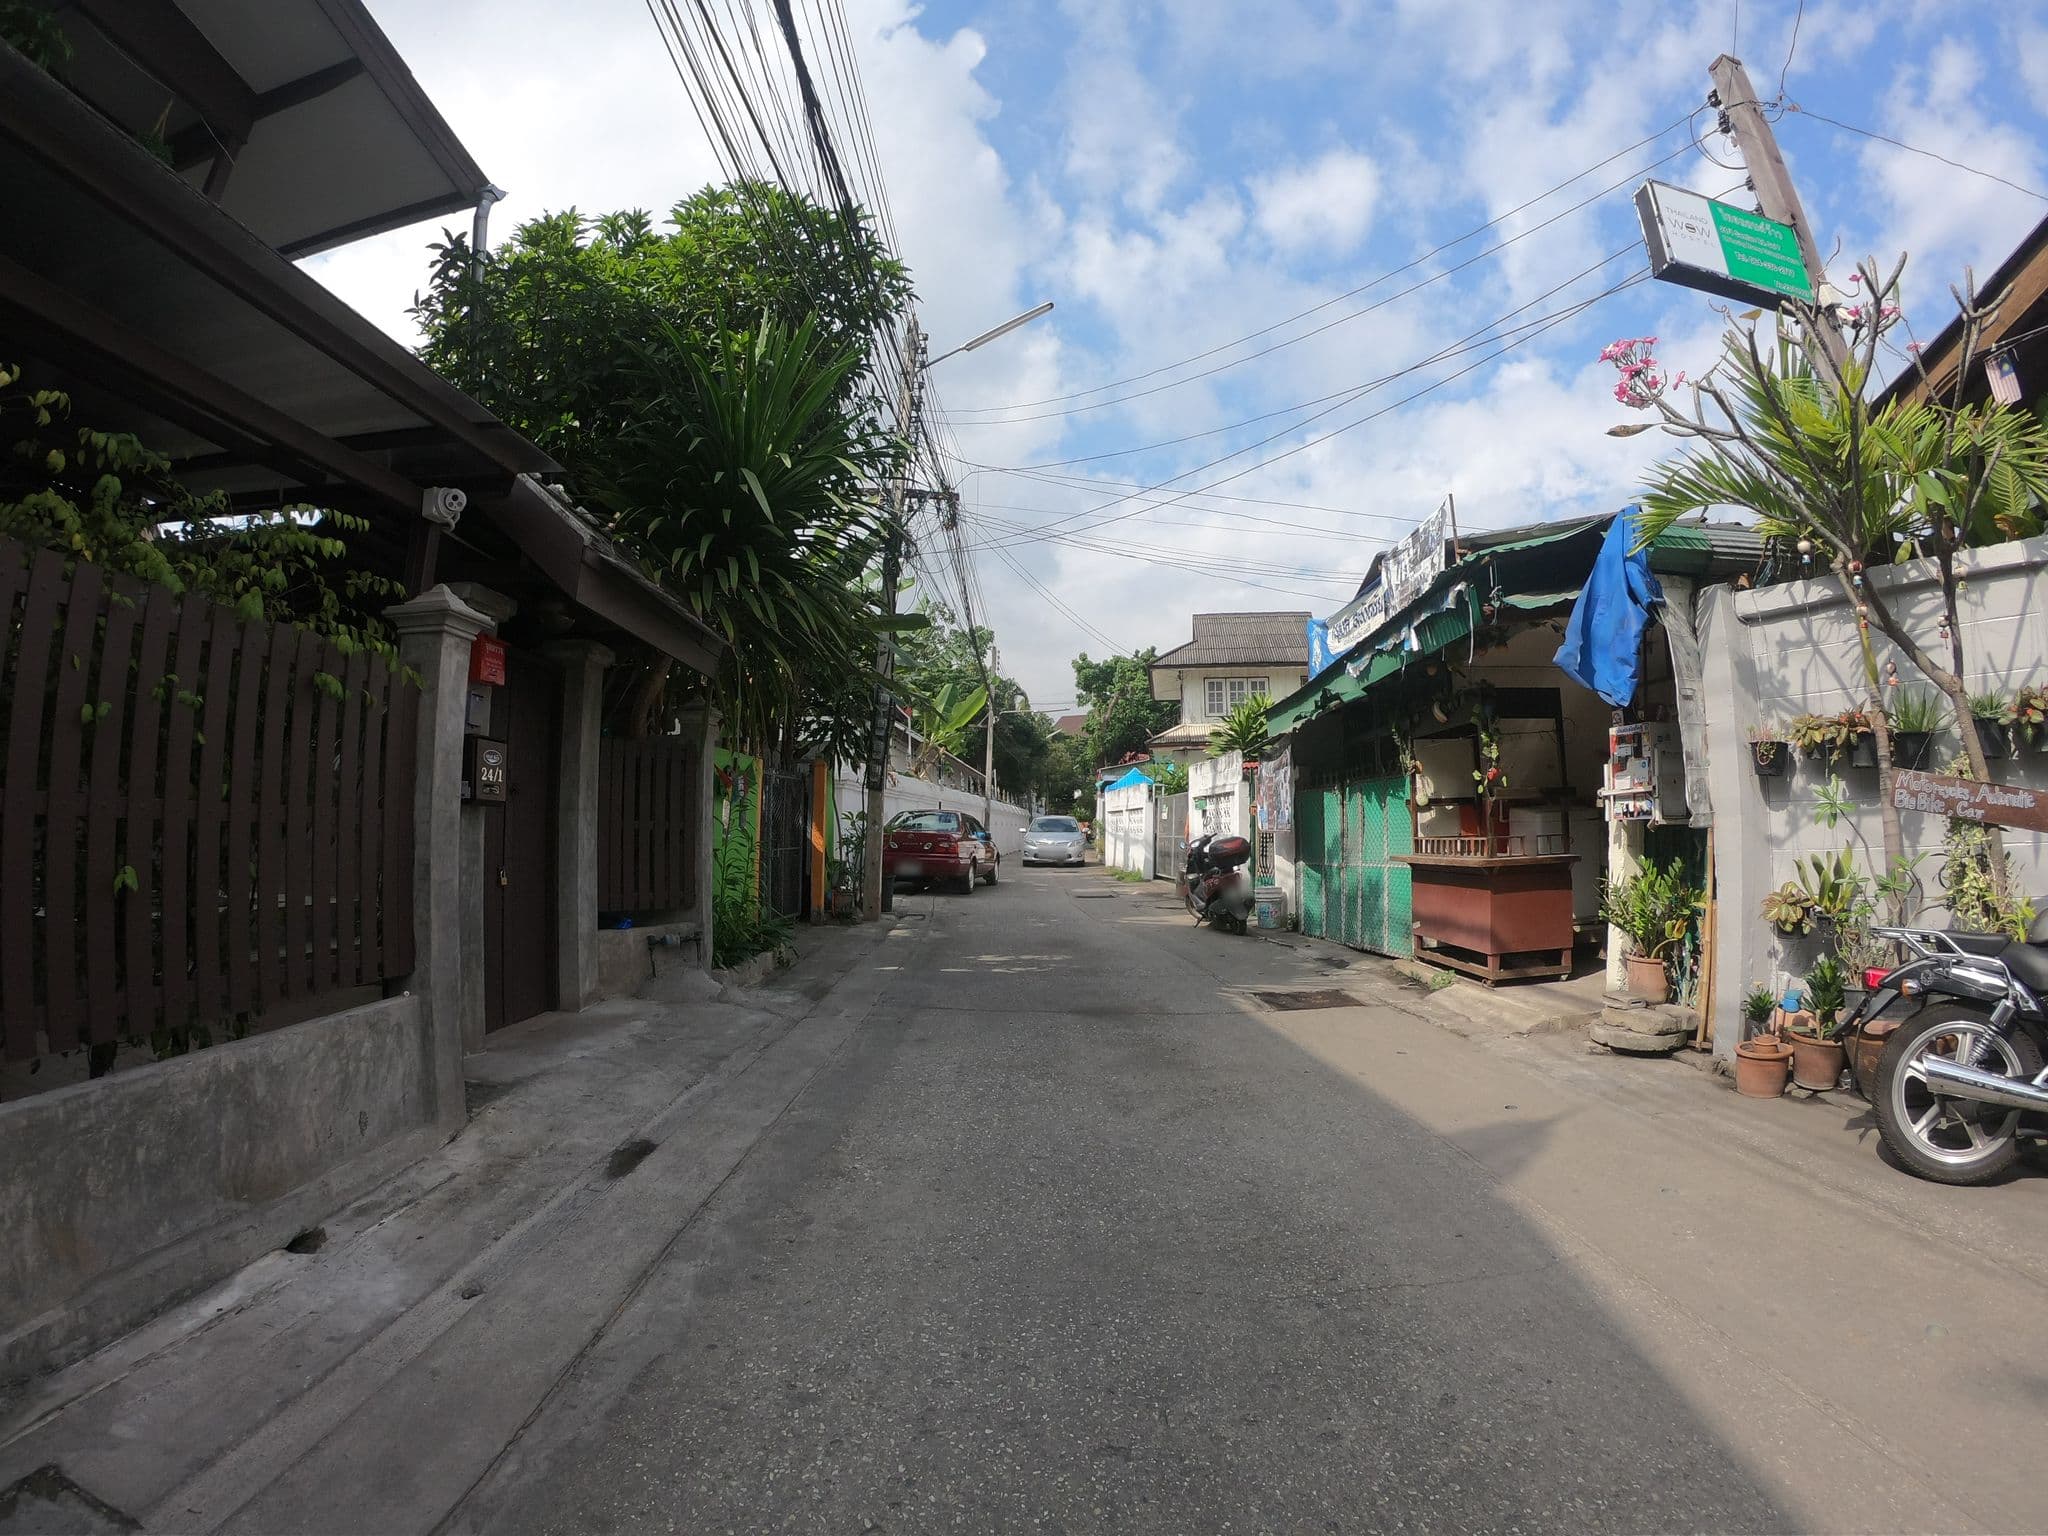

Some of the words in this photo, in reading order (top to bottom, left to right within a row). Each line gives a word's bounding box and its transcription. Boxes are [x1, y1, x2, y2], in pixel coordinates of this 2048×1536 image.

[1668, 217, 1711, 239] WOW
[481, 766, 503, 783] 24/1
[1956, 800, 1985, 819] Car
